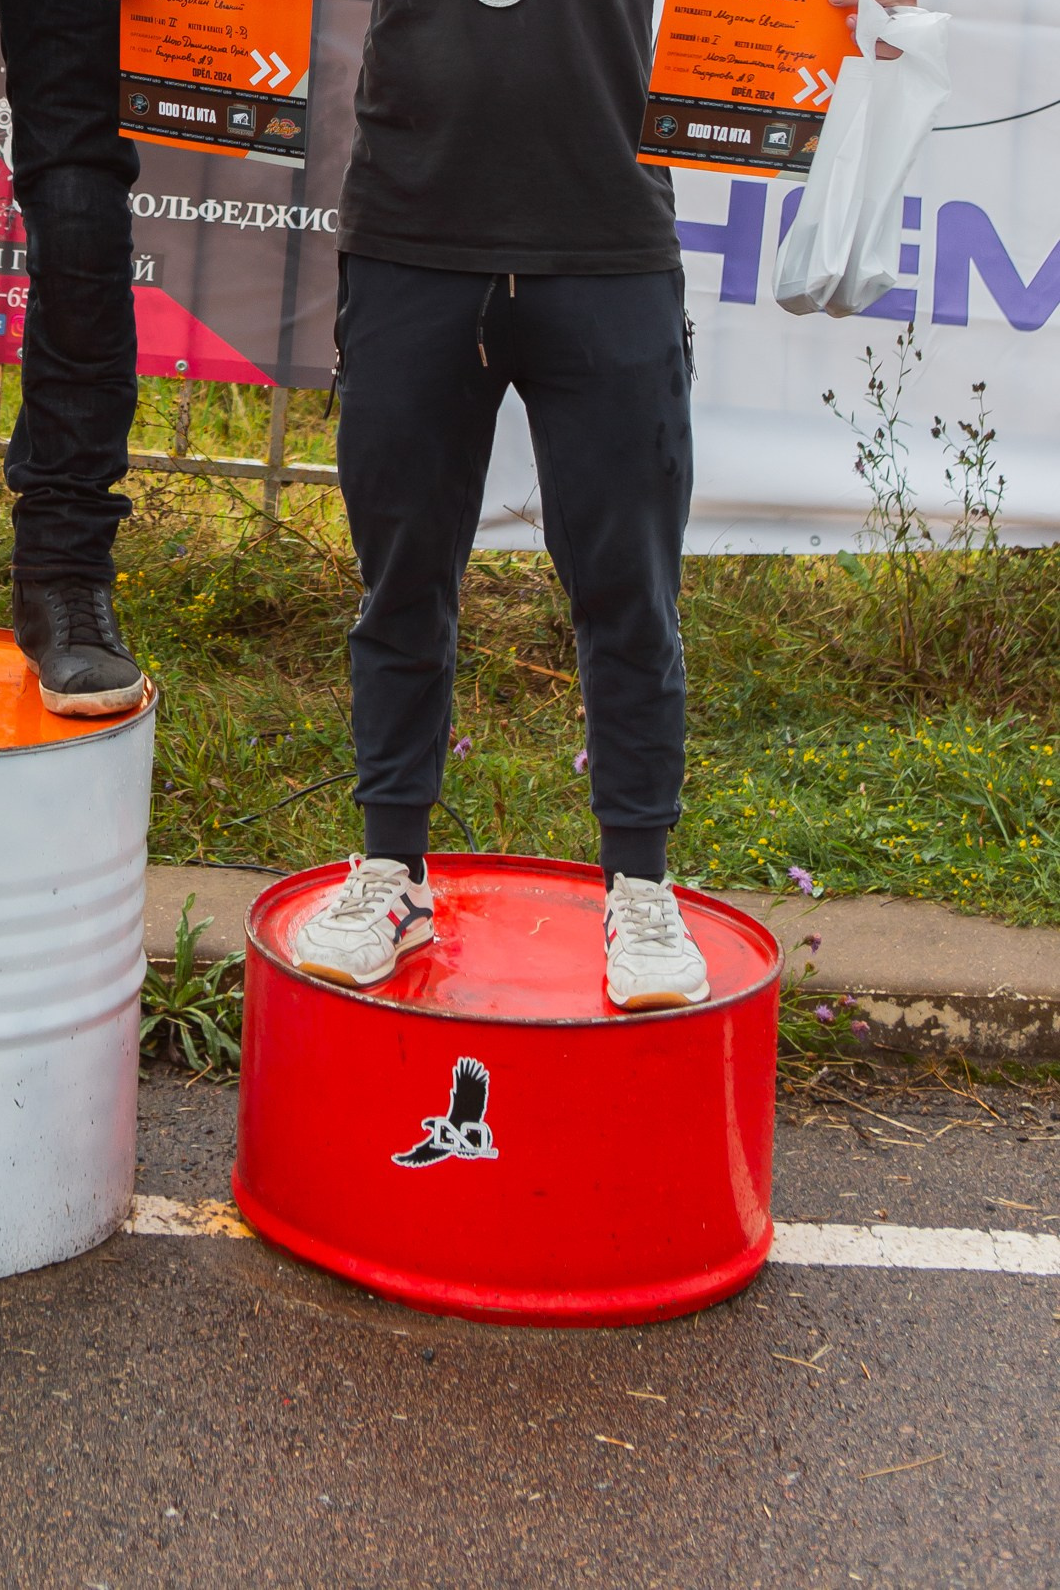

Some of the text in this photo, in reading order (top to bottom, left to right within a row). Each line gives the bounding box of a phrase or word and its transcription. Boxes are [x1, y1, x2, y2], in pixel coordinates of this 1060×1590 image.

[214, 71, 231, 82] 2024
[755, 89, 775, 100] 2024
[158, 101, 216, 123] ООО ТД ИТА
[687, 123, 752, 143] ООО ТД ИТА
[128, 192, 339, 233] ОЛЬФЕДЖИО
